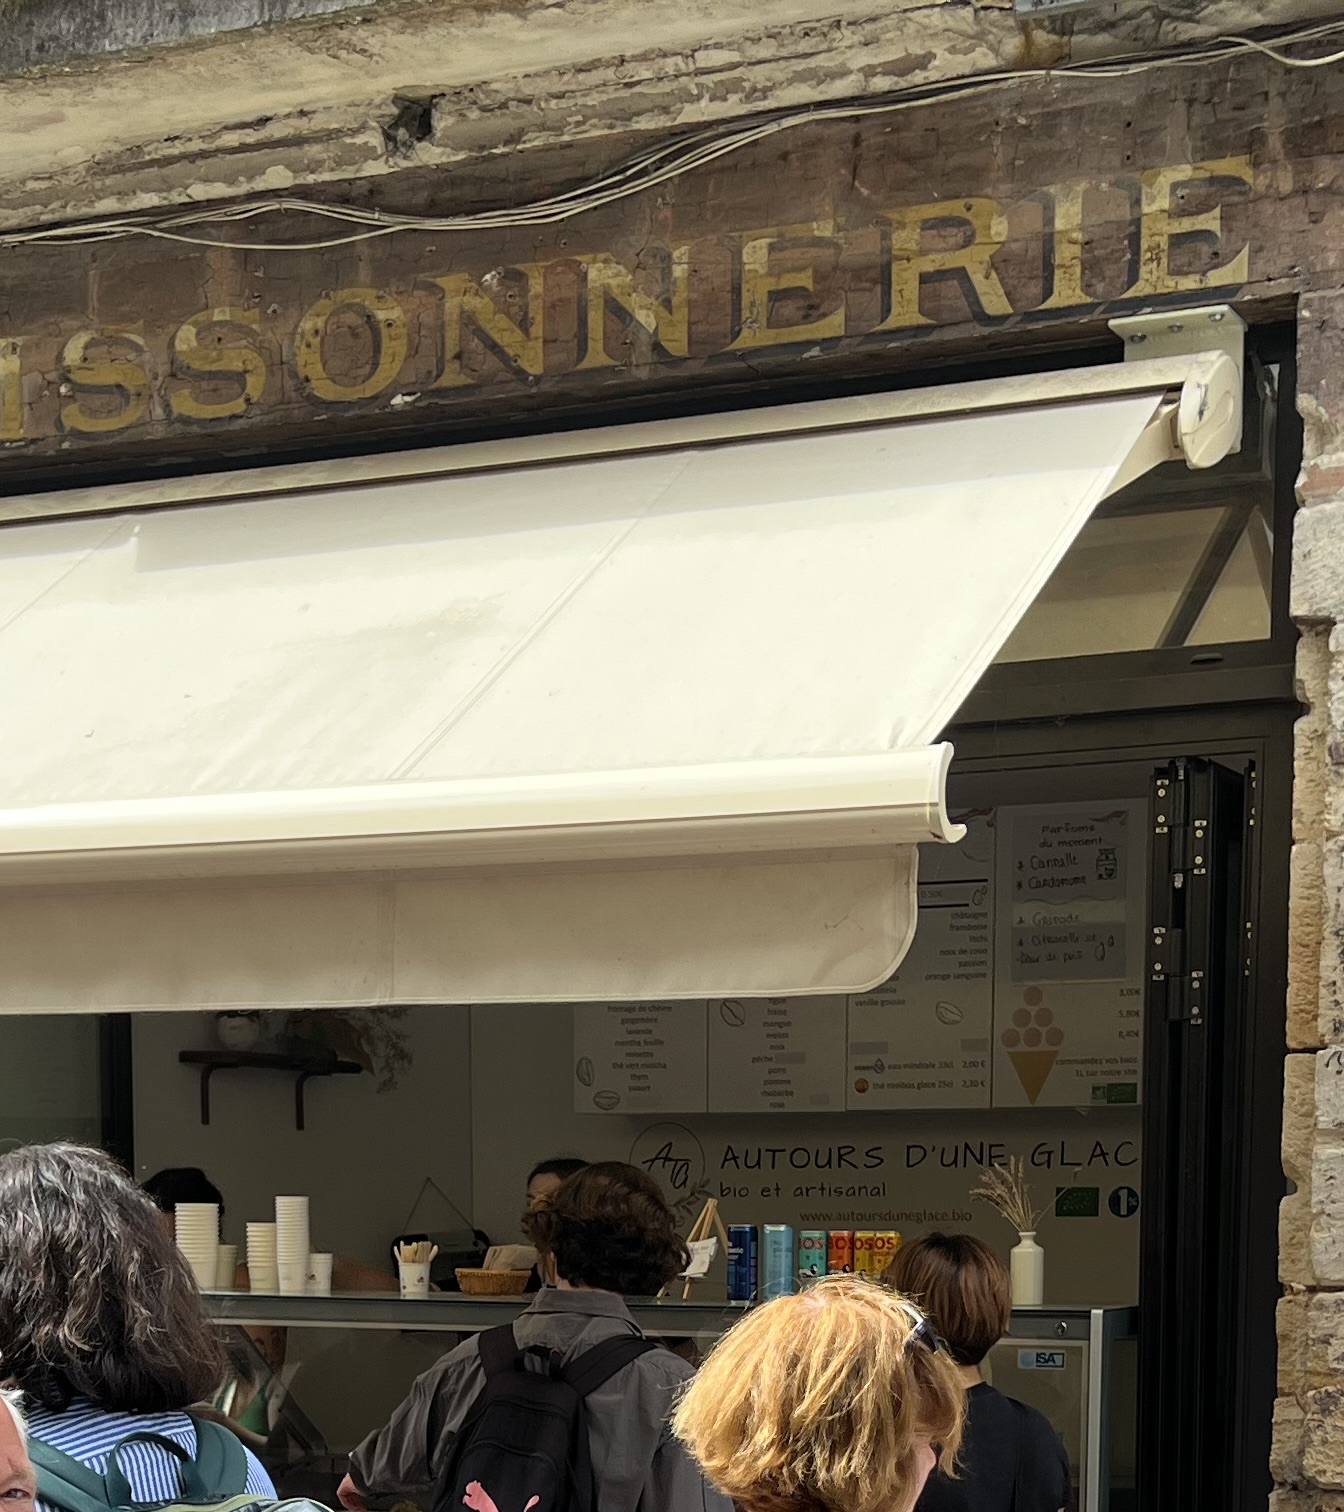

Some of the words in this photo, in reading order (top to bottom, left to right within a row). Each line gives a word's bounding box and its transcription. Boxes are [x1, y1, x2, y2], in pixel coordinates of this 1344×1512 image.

[719, 1143, 886, 1171] AUTOURS
[905, 1141, 1009, 1169] D'UNE
[719, 1181, 750, 1199] bio
[760, 1183, 782, 1199] et
[793, 1181, 886, 1199] artisanal
[799, 1208, 973, 1226] www.autoursduneglace.bio
